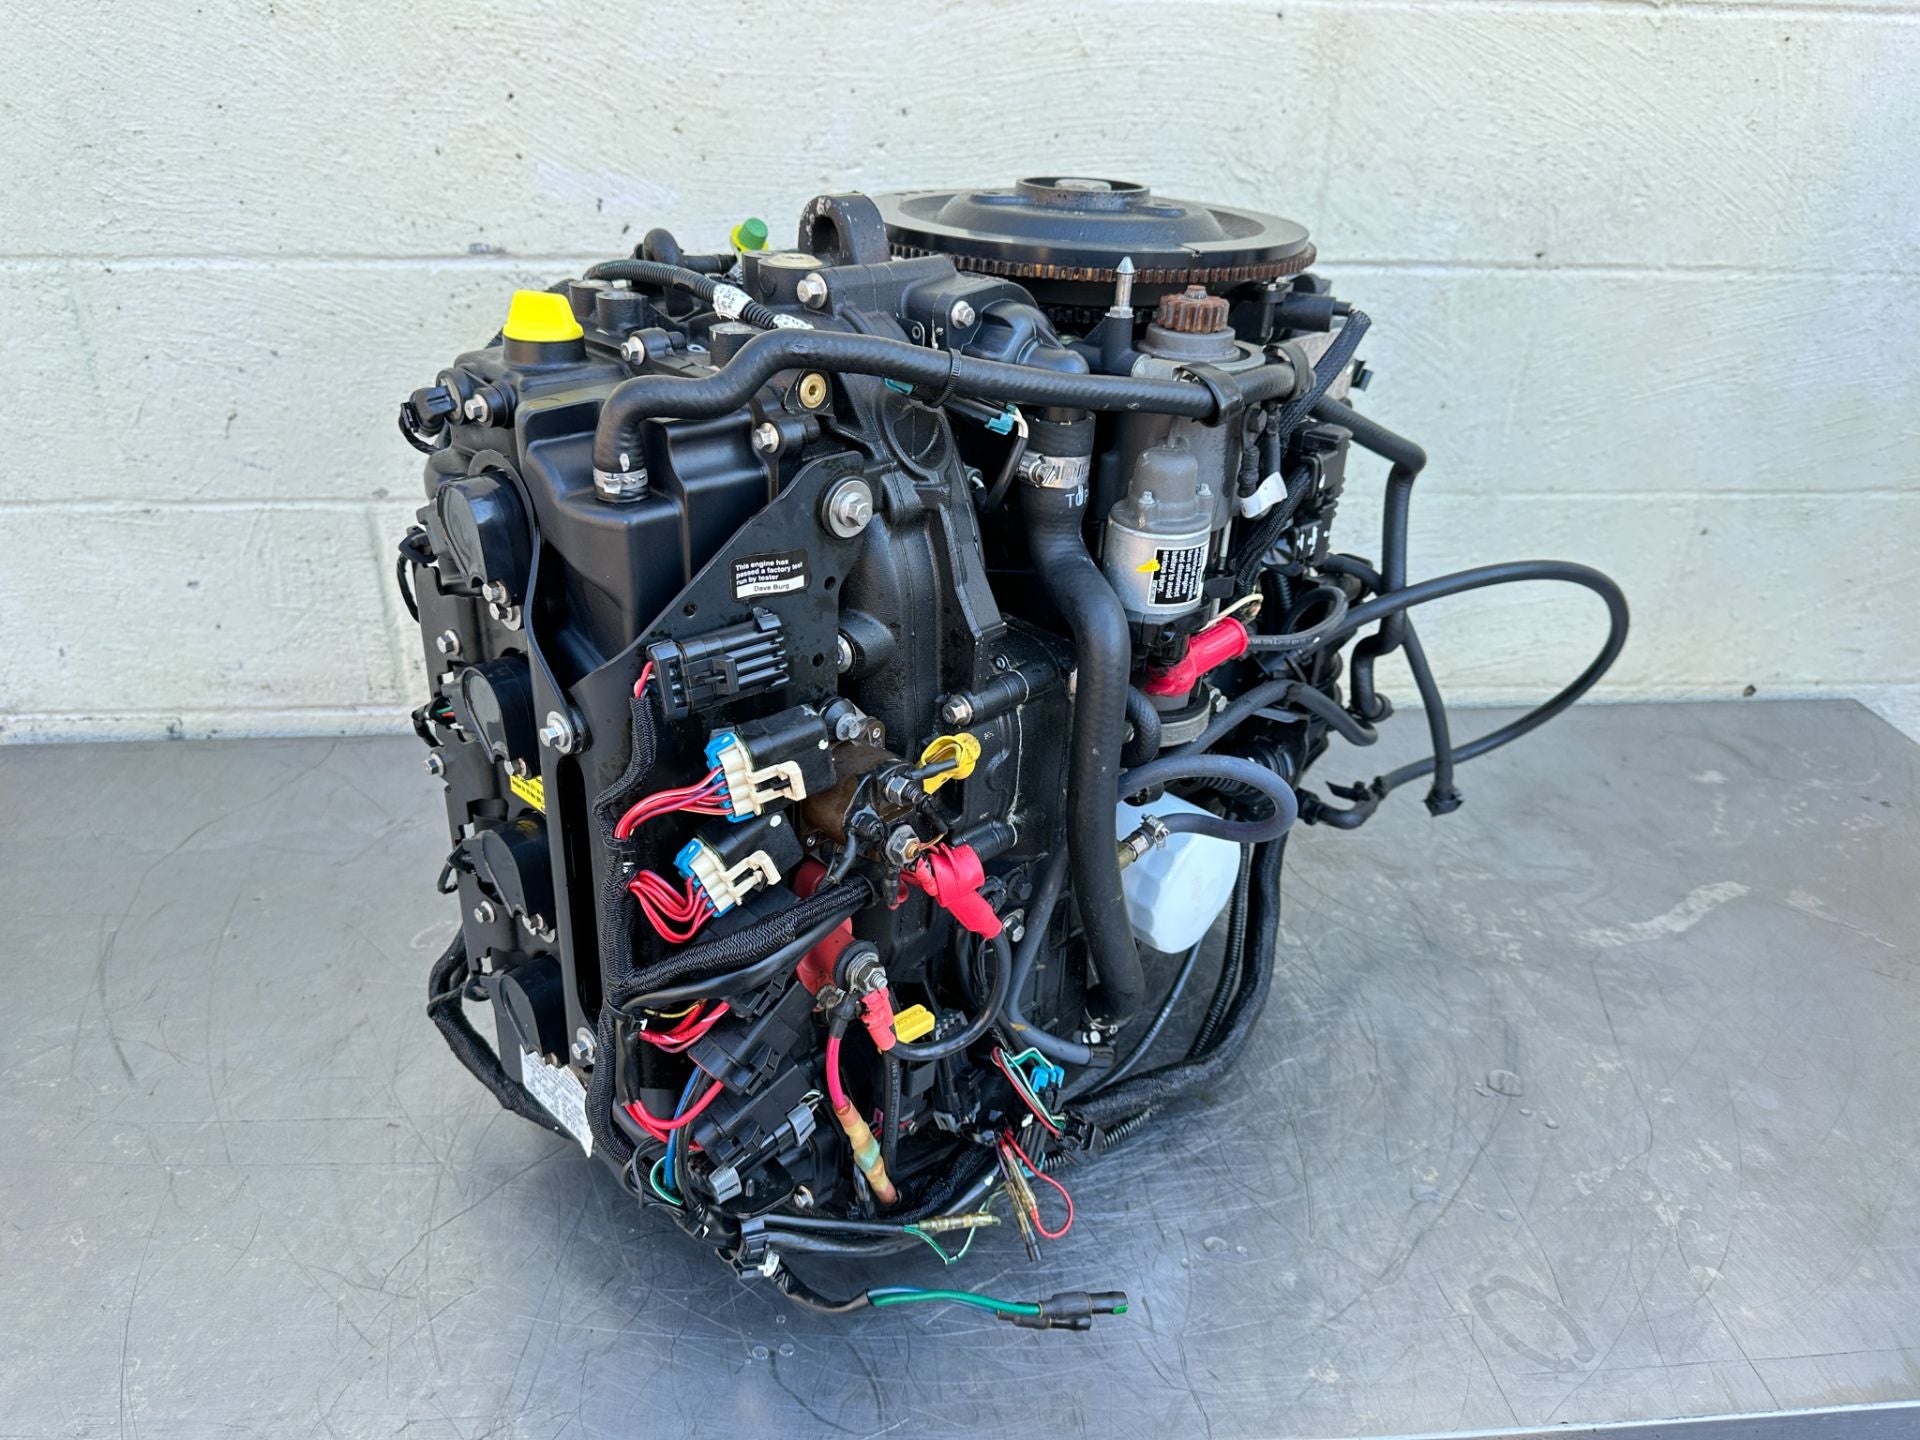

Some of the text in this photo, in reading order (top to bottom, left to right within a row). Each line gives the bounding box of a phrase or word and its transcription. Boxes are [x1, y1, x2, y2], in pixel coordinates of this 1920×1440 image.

[1065, 488, 1089, 508] TOP
[736, 568, 759, 579] passed
[767, 565, 791, 573] factory
[750, 560, 774, 568] engine
[1157, 550, 1169, 593] serious injury.
[1168, 551, 1178, 573] battery
[1165, 582, 1173, 598] avoid
[1173, 563, 1184, 597] disconnect
